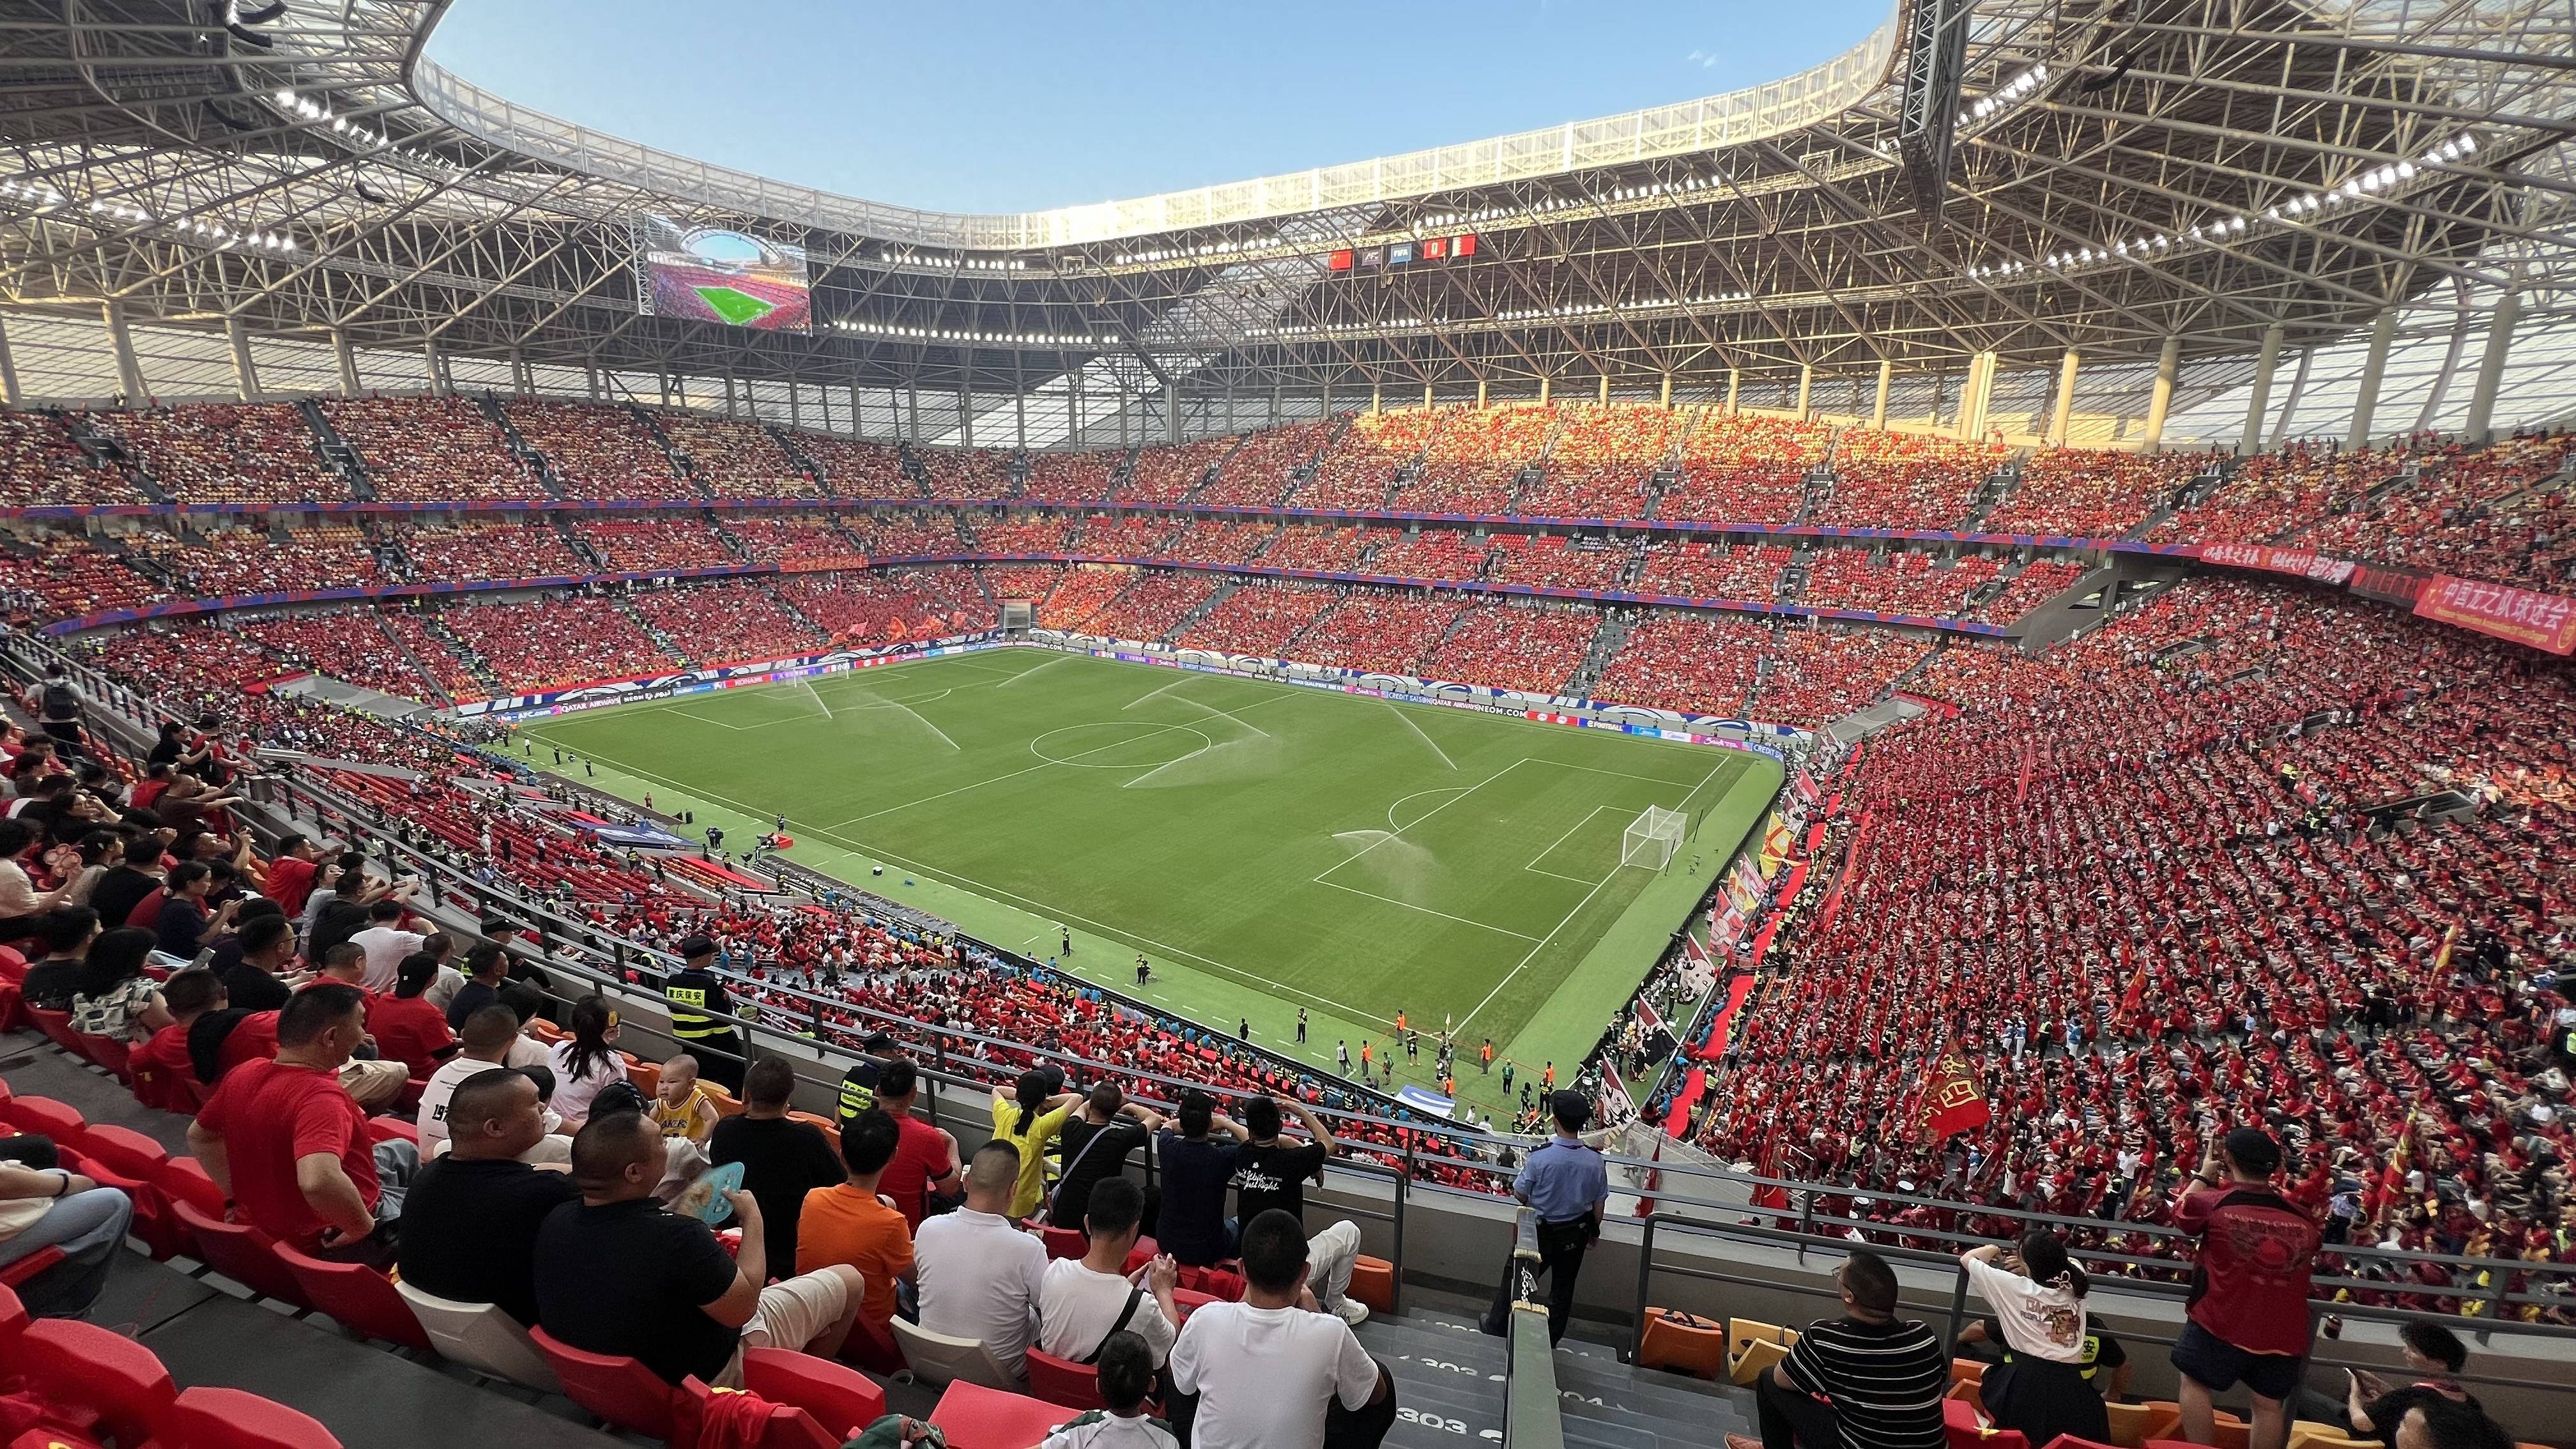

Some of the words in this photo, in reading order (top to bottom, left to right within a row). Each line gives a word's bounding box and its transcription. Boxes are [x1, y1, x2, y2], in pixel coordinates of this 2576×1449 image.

[1393, 249, 1408, 257] FIFA
[561, 703, 587, 713] QATAR
[589, 696, 621, 708] AIRWAYS
[1389, 693, 1407, 701] CREDIT
[1409, 695, 1431, 704] SAISON
[1432, 698, 1452, 707] QATAR
[1453, 702, 1478, 710] AIRWAYS
[1478, 704, 1526, 718] NEOM.COM
[1753, 744, 1775, 756] CREDIT
[669, 989, 702, 1000] 重庆保安
[661, 1119, 688, 1129] AKERS
[1397, 1407, 1467, 1435] 303
